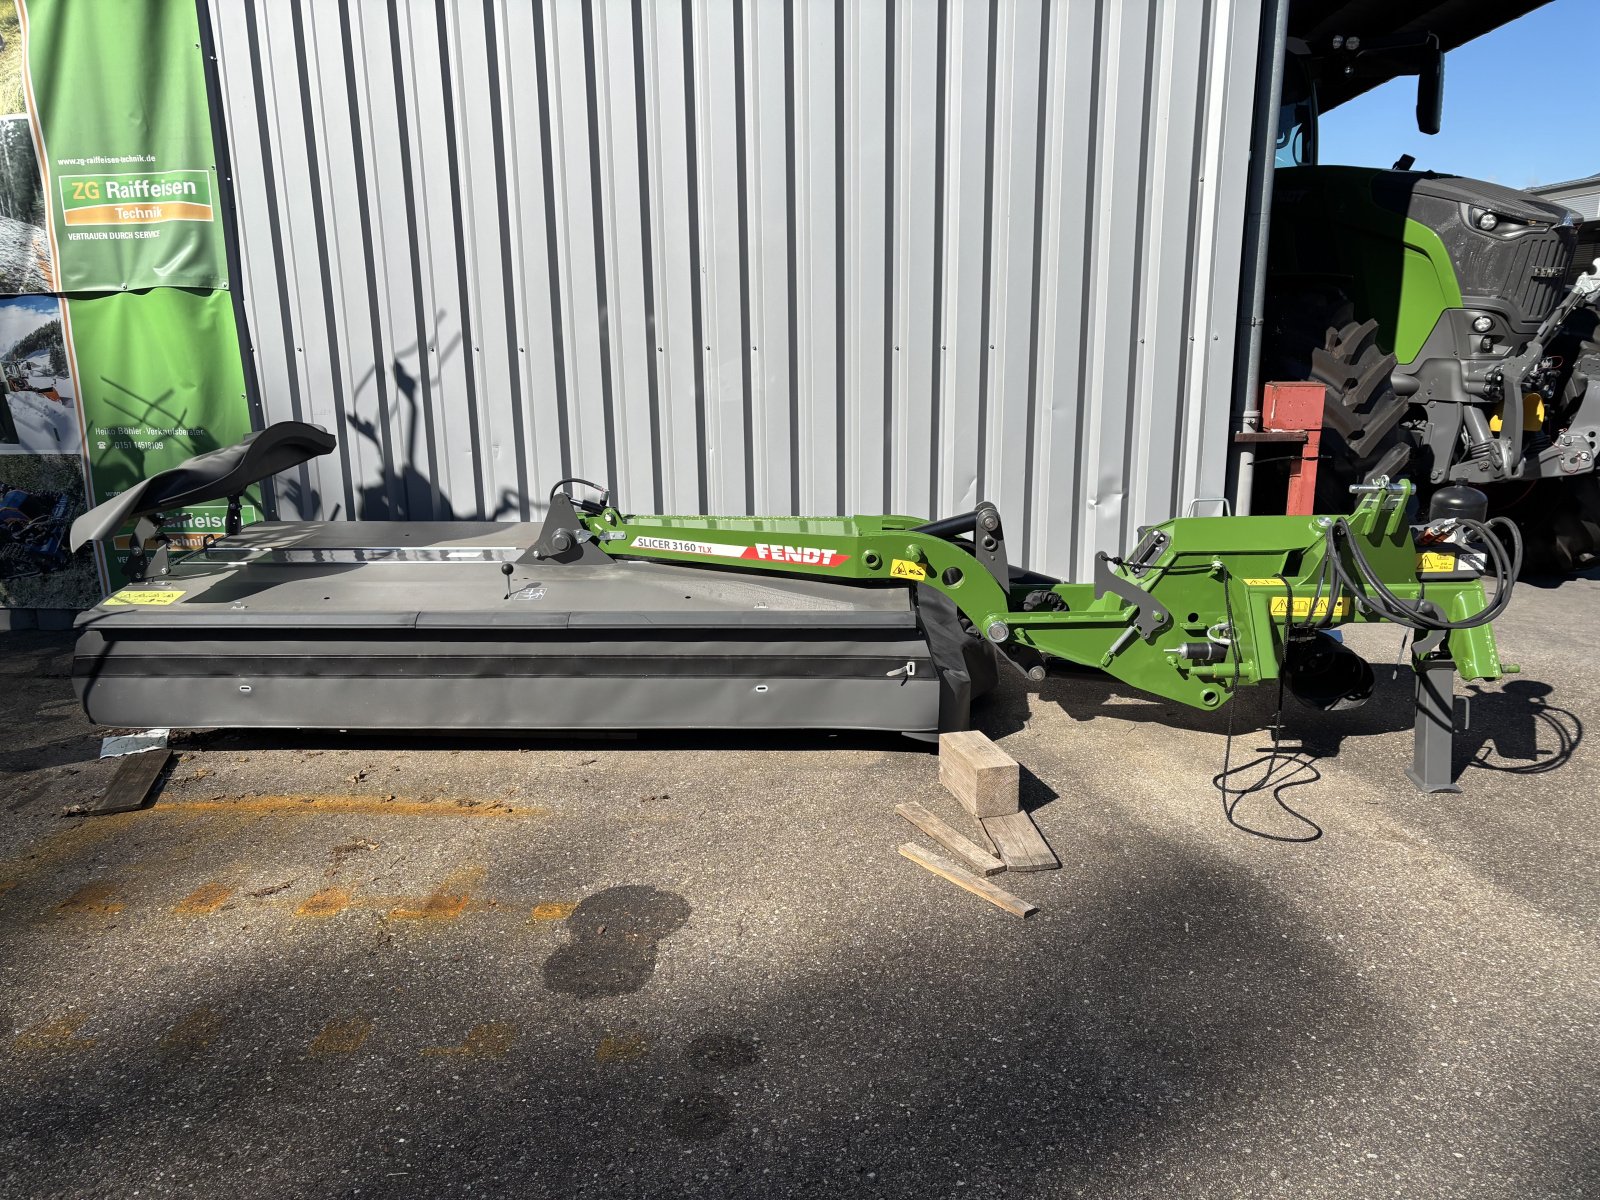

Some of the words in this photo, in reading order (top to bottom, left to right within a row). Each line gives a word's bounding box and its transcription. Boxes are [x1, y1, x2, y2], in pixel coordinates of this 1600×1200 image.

[57, 154, 156, 166] www.zg-raiffeisen-technik.de
[71, 181, 100, 200] ZG
[105, 179, 196, 199] Raiffeisen
[115, 206, 163, 220] Technik
[68, 232, 108, 241] VERTRAUEN
[110, 231, 133, 240] DURCH
[135, 230, 161, 238] SERVICE
[95, 427, 116, 436] Heiko
[114, 441, 132, 449] 0151
[637, 537, 670, 550] SLICER
[672, 541, 696, 552] 3160
[698, 545, 712, 554] TLX
[755, 543, 837, 565] FENDT
